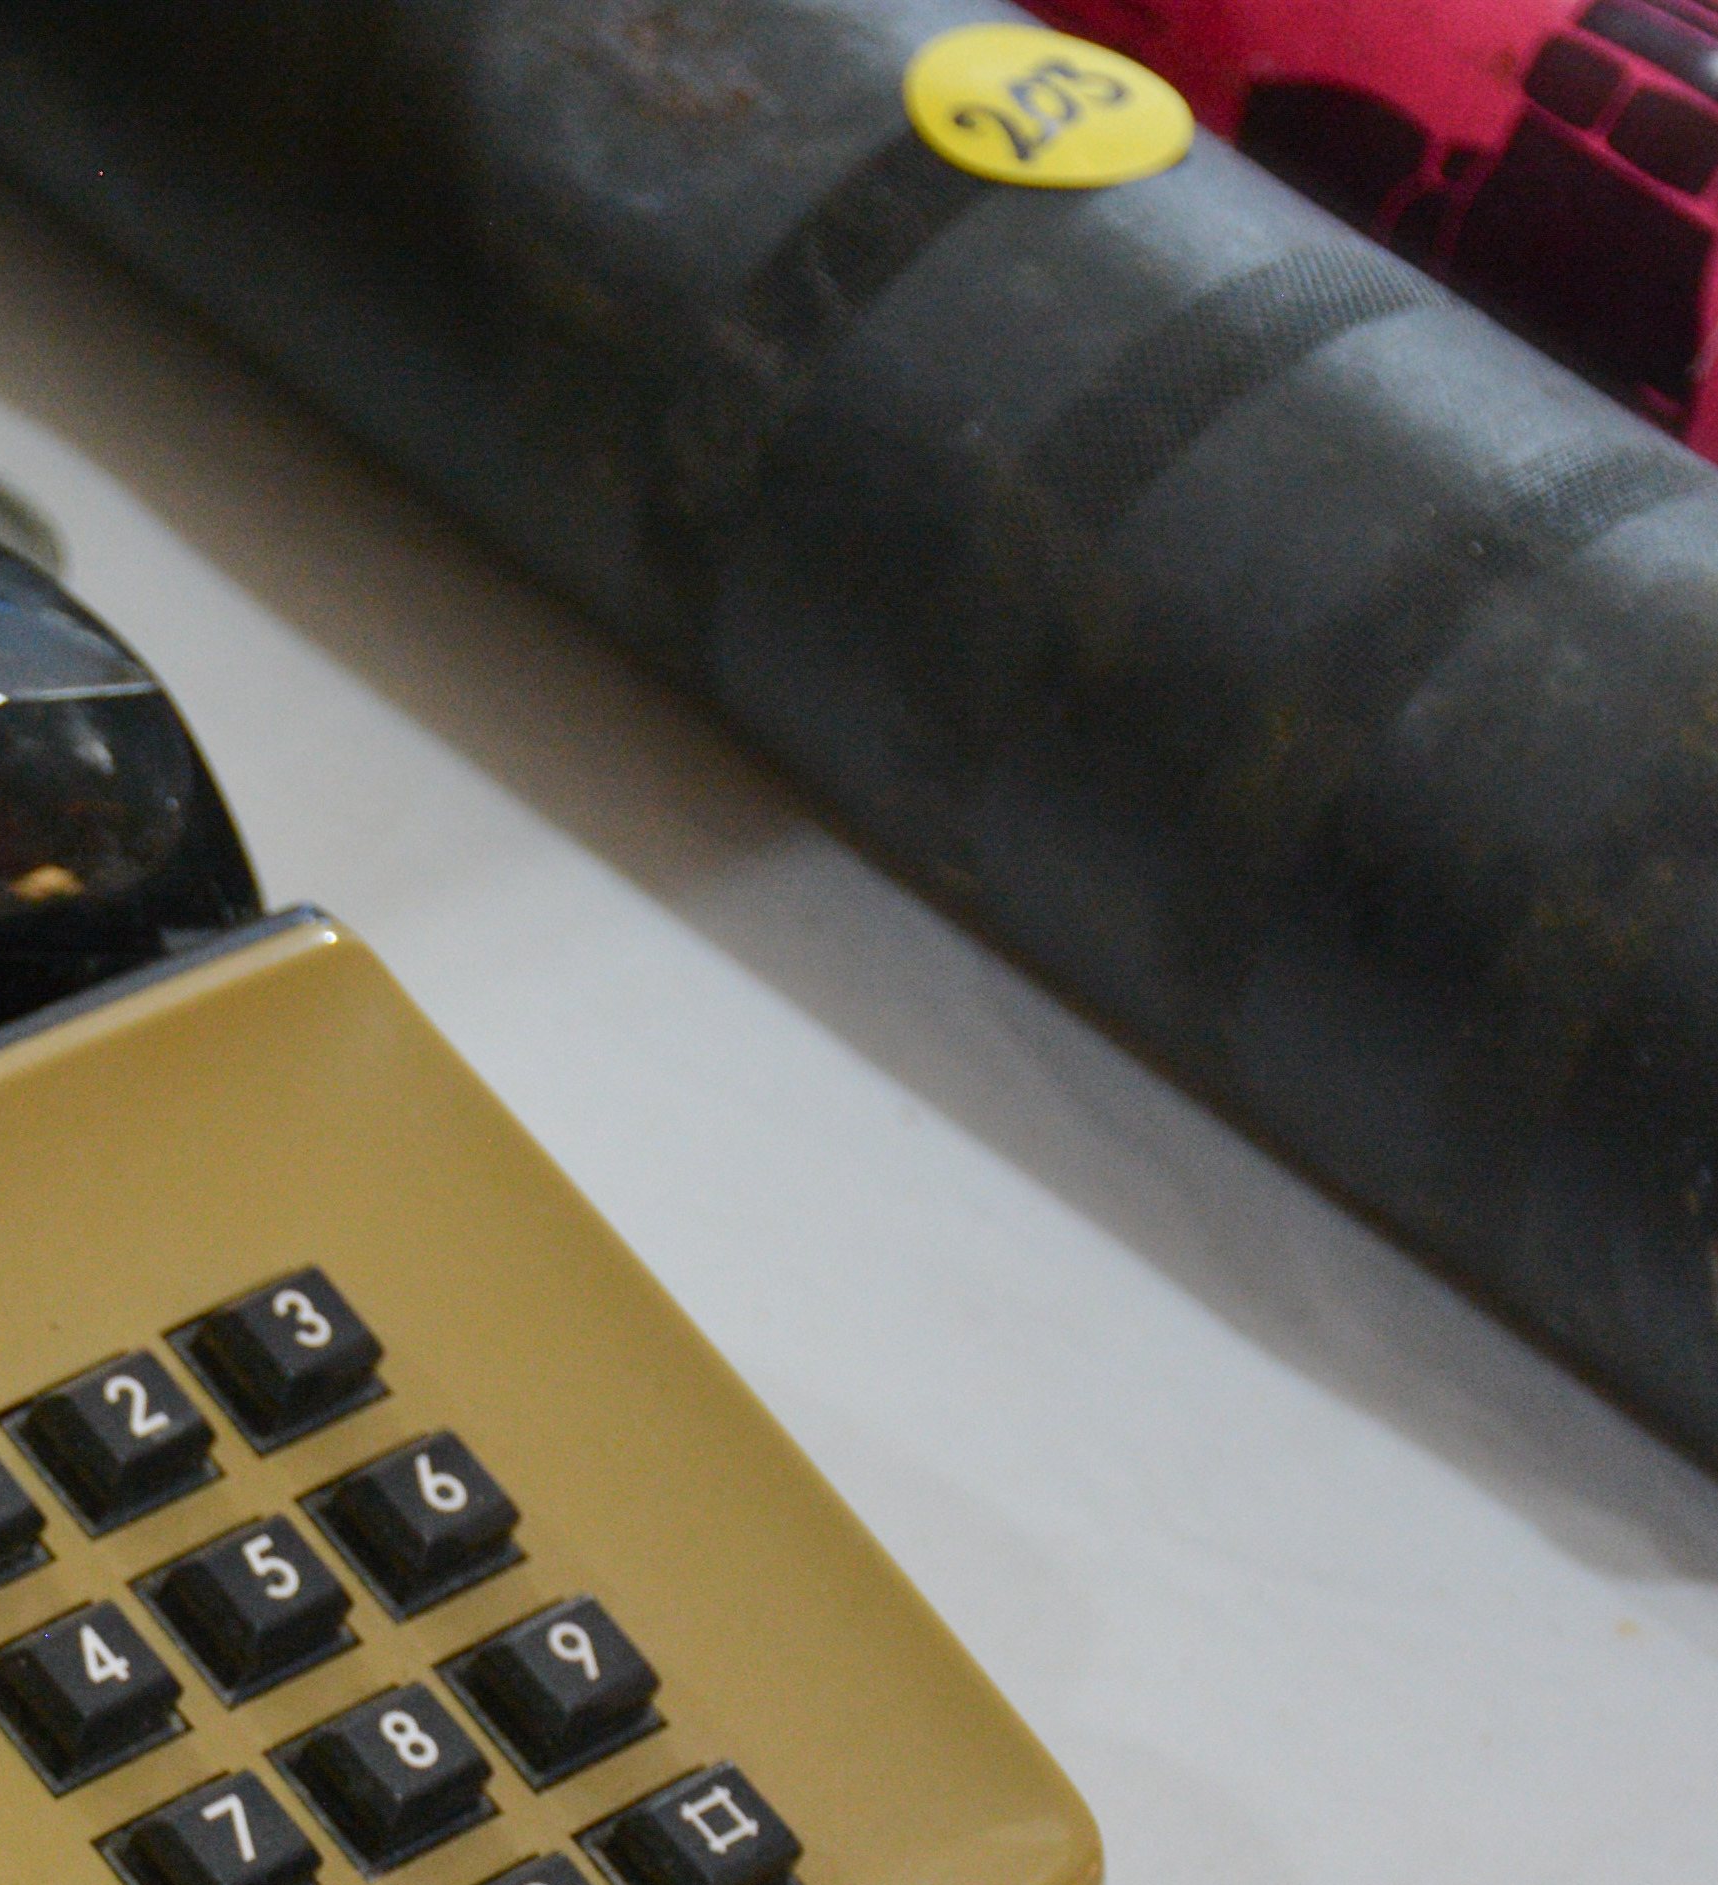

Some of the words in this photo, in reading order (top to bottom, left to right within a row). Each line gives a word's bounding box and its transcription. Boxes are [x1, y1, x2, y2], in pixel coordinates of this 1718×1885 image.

[103, 1374, 168, 1438] 2
[271, 1288, 331, 1349] 3
[81, 1625, 131, 1687] 4
[242, 1535, 299, 1600] 5
[415, 1453, 467, 1512] 6
[203, 1794, 256, 1862] 7
[379, 1710, 439, 1769] 8
[549, 1622, 599, 1681] 9
